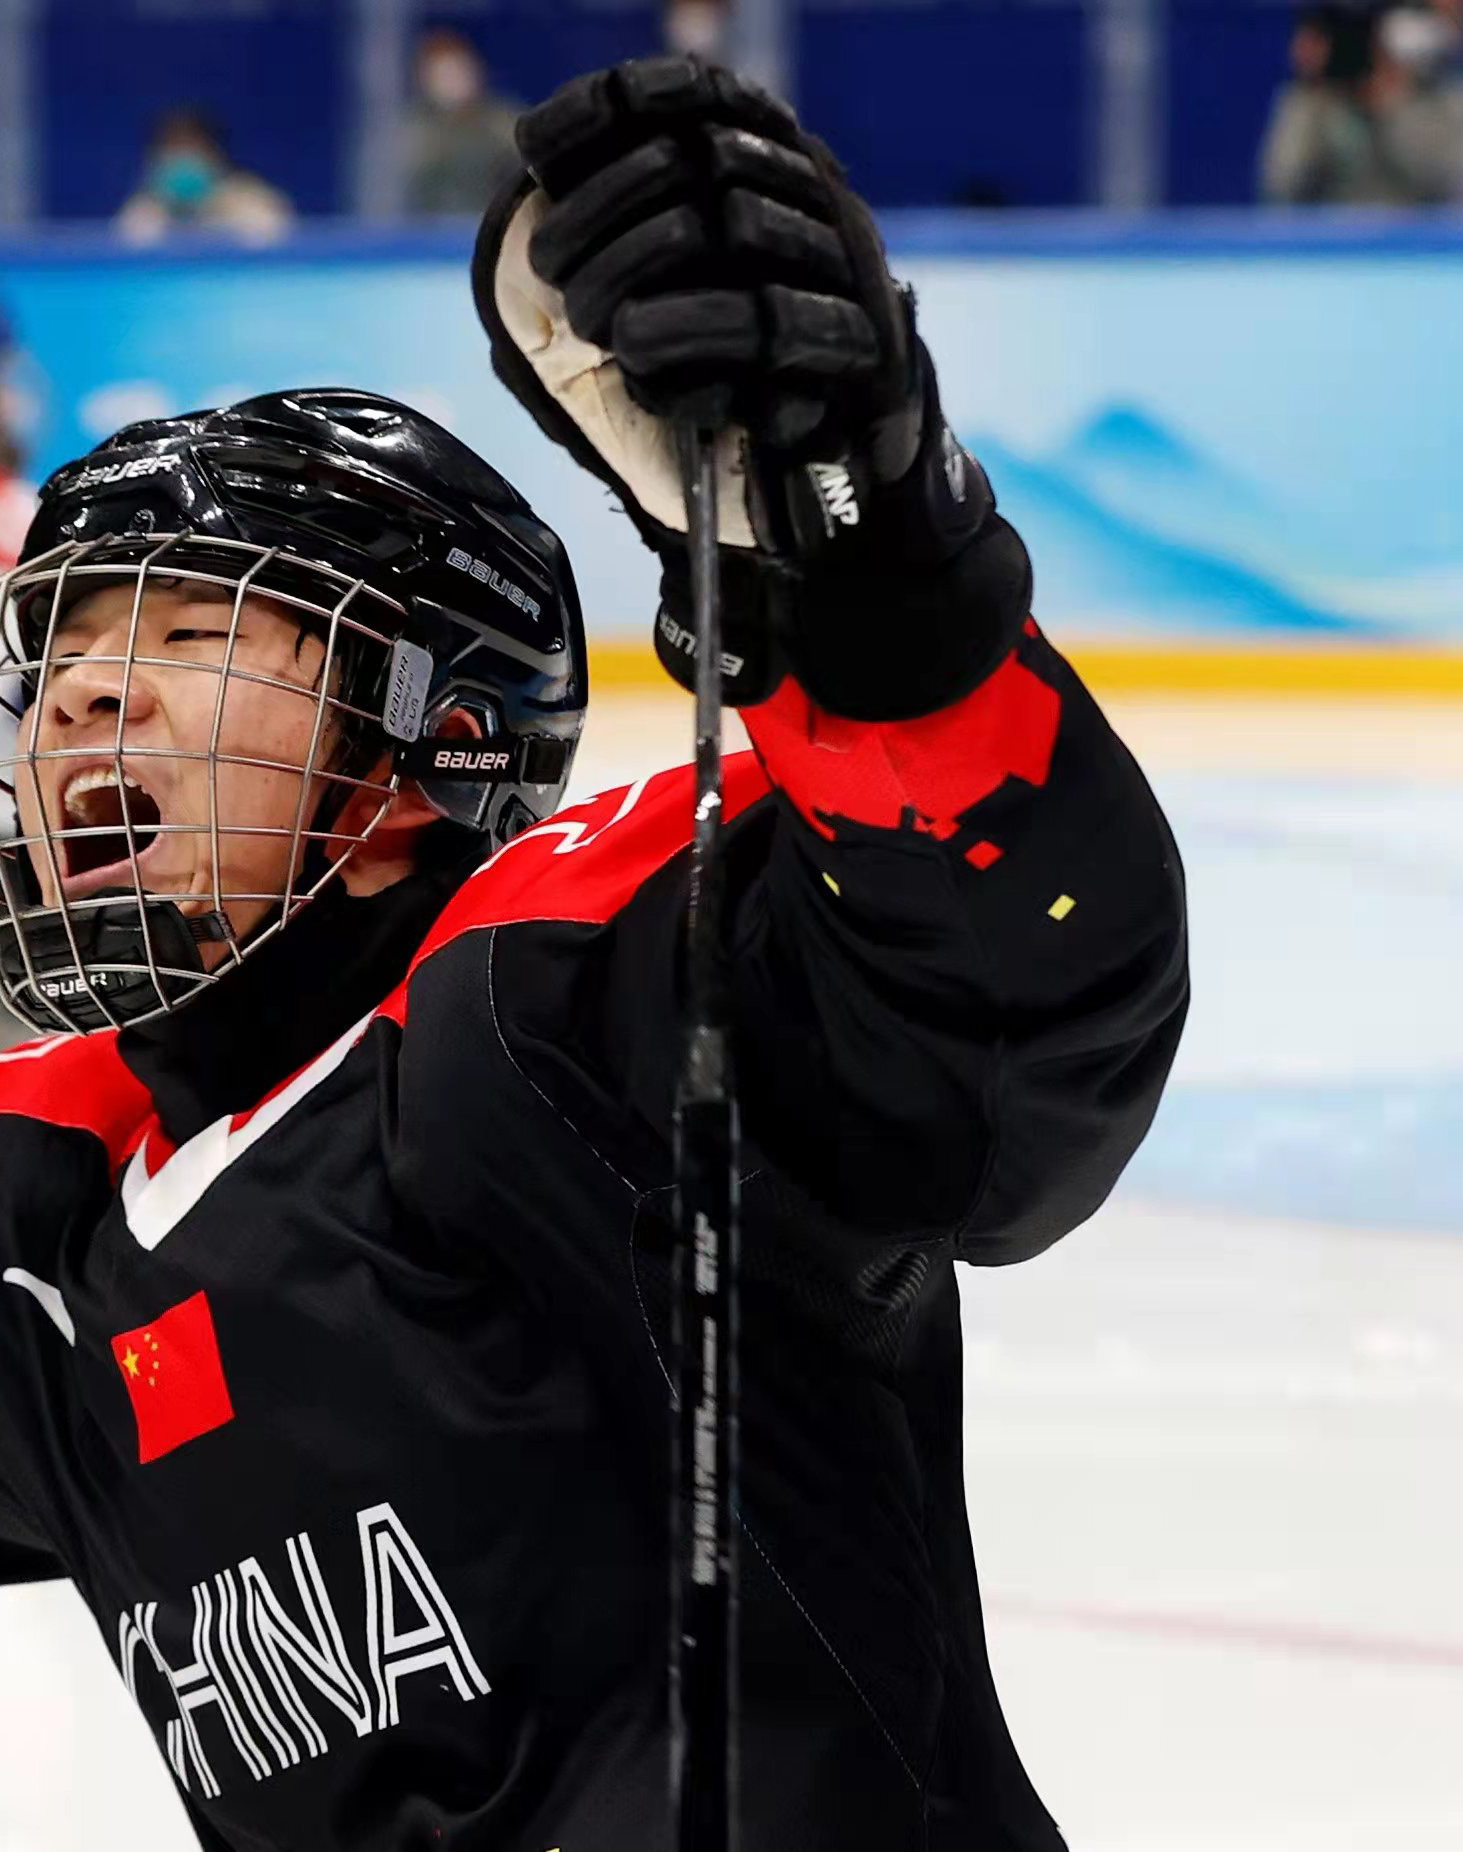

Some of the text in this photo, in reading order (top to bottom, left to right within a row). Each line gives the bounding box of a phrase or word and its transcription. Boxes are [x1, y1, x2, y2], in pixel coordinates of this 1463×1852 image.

[446, 547, 542, 623] BAUER
[434, 751, 510, 770] BAUER
[40, 972, 108, 998] AUER
[119, 1502, 493, 1799] CHINA
